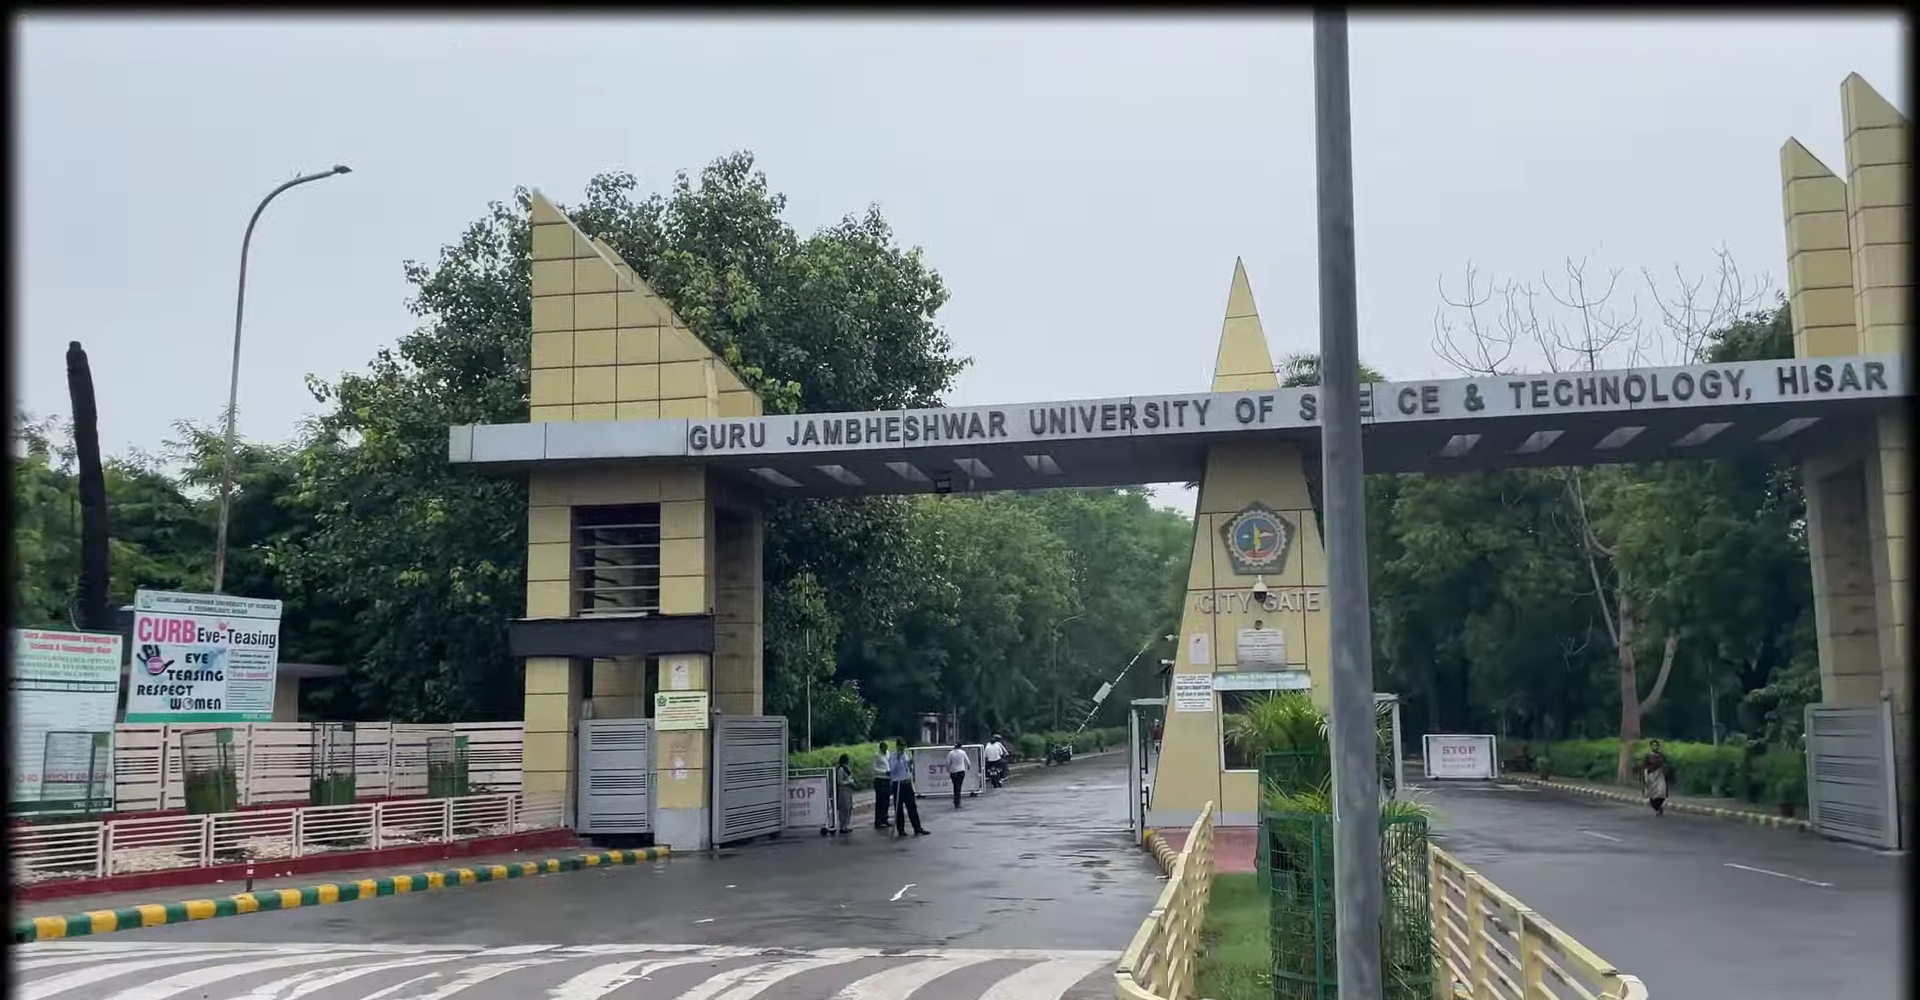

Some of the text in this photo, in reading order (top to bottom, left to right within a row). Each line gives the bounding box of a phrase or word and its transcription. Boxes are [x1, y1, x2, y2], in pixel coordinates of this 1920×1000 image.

[690, 422, 766, 450] GURU
[786, 411, 1007, 446] JAMBHESHWAR
[1029, 398, 1212, 435] UNIVERSITY
[1235, 395, 1275, 424] OF
[1463, 383, 1486, 412] &
[1508, 369, 1752, 410] TECHNOLOGY,
[1778, 361, 1888, 396] HISAR
[1199, 591, 1321, 614] CITY GATE
[138, 617, 196, 644] CURB
[197, 627, 277, 648] Eve-Teasing
[185, 653, 209, 664] EVE
[167, 669, 224, 681] TEASING
[137, 685, 194, 696] RESPECT
[1442, 745, 1476, 755] STOP
[928, 764, 951, 775] ST
[787, 787, 815, 799] TOP
